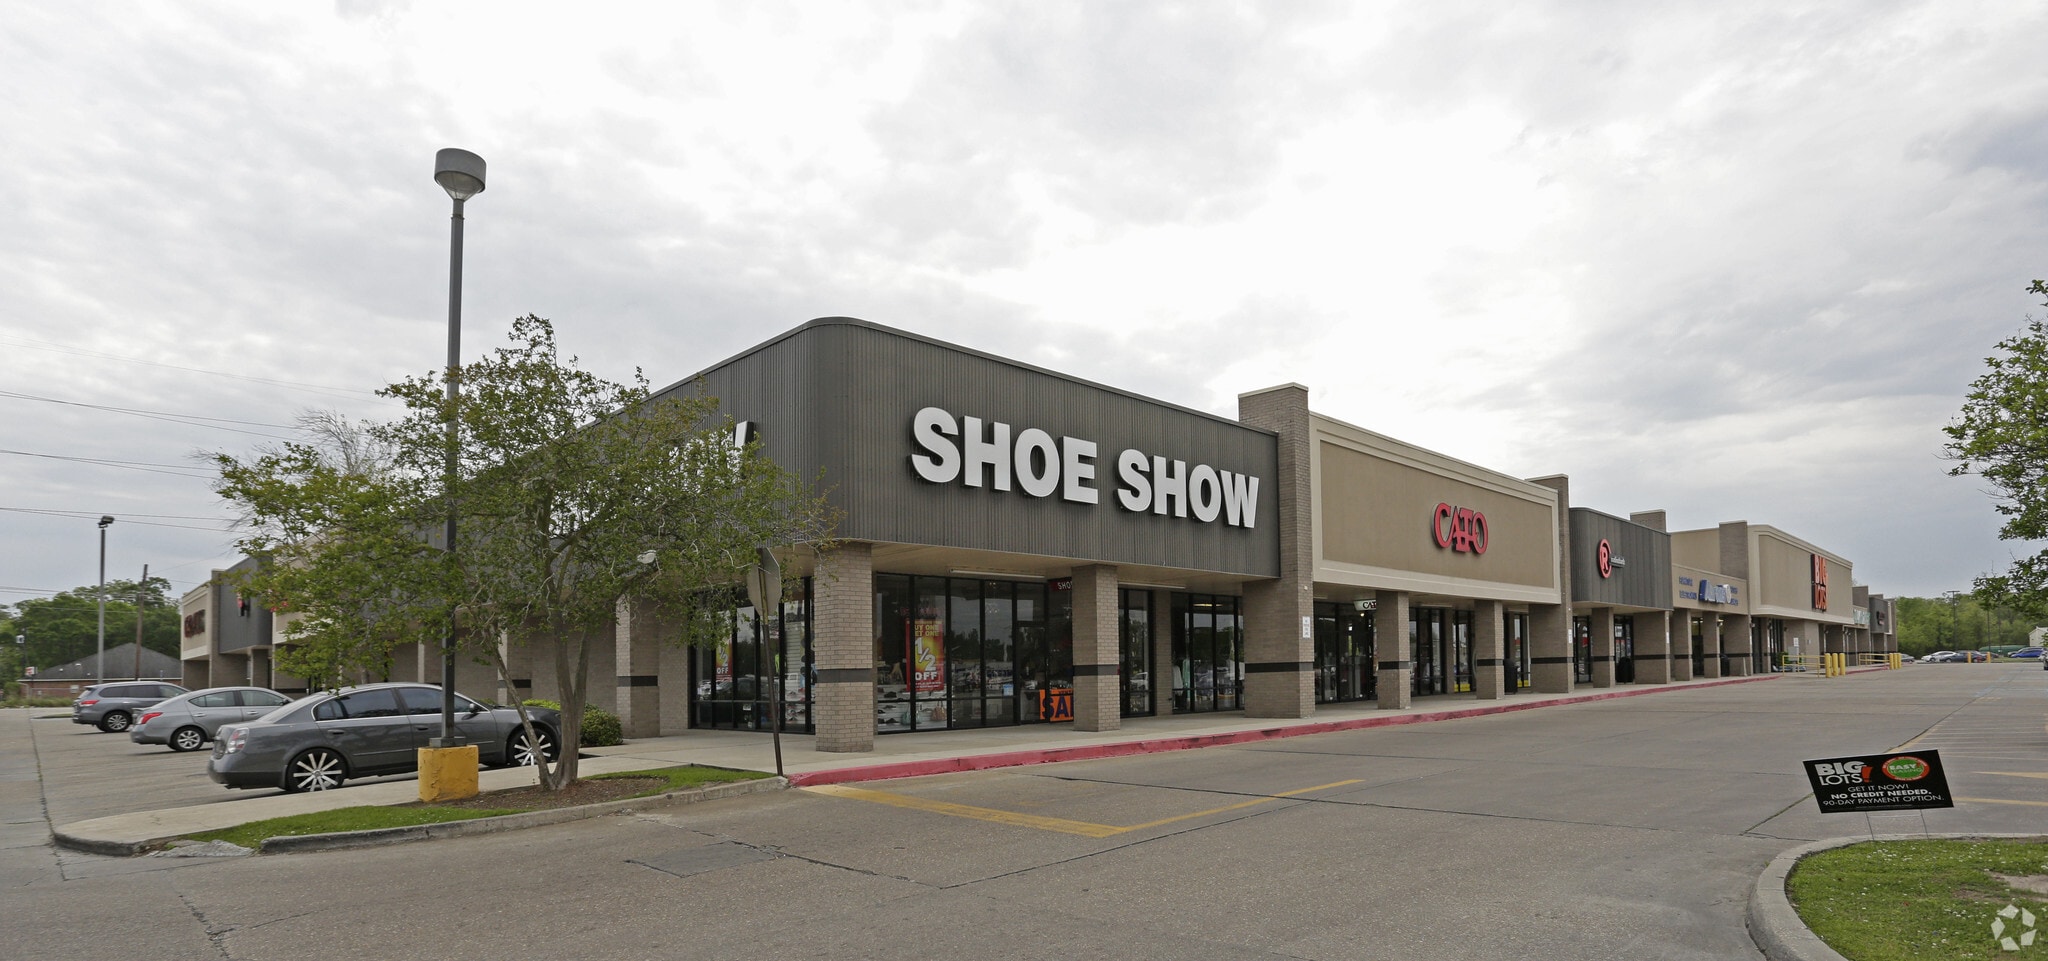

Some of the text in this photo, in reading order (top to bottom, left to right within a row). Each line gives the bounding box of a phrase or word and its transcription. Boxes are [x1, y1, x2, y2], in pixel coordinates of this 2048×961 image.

[911, 406, 1260, 529] SHOE SHOW
[1431, 502, 1489, 555] CATO
[716, 667, 729, 675] OFF
[915, 671, 938, 681] OFF
[1814, 761, 1867, 776] BIG
[1847, 785, 1865, 793] GET
[1877, 783, 1910, 791] NOW!
[1850, 791, 1885, 799] CREDIT
[1887, 788, 1932, 796] NEEDED.
[1857, 796, 1900, 804] PAYMENT
[1902, 794, 1945, 802] OPTION.
